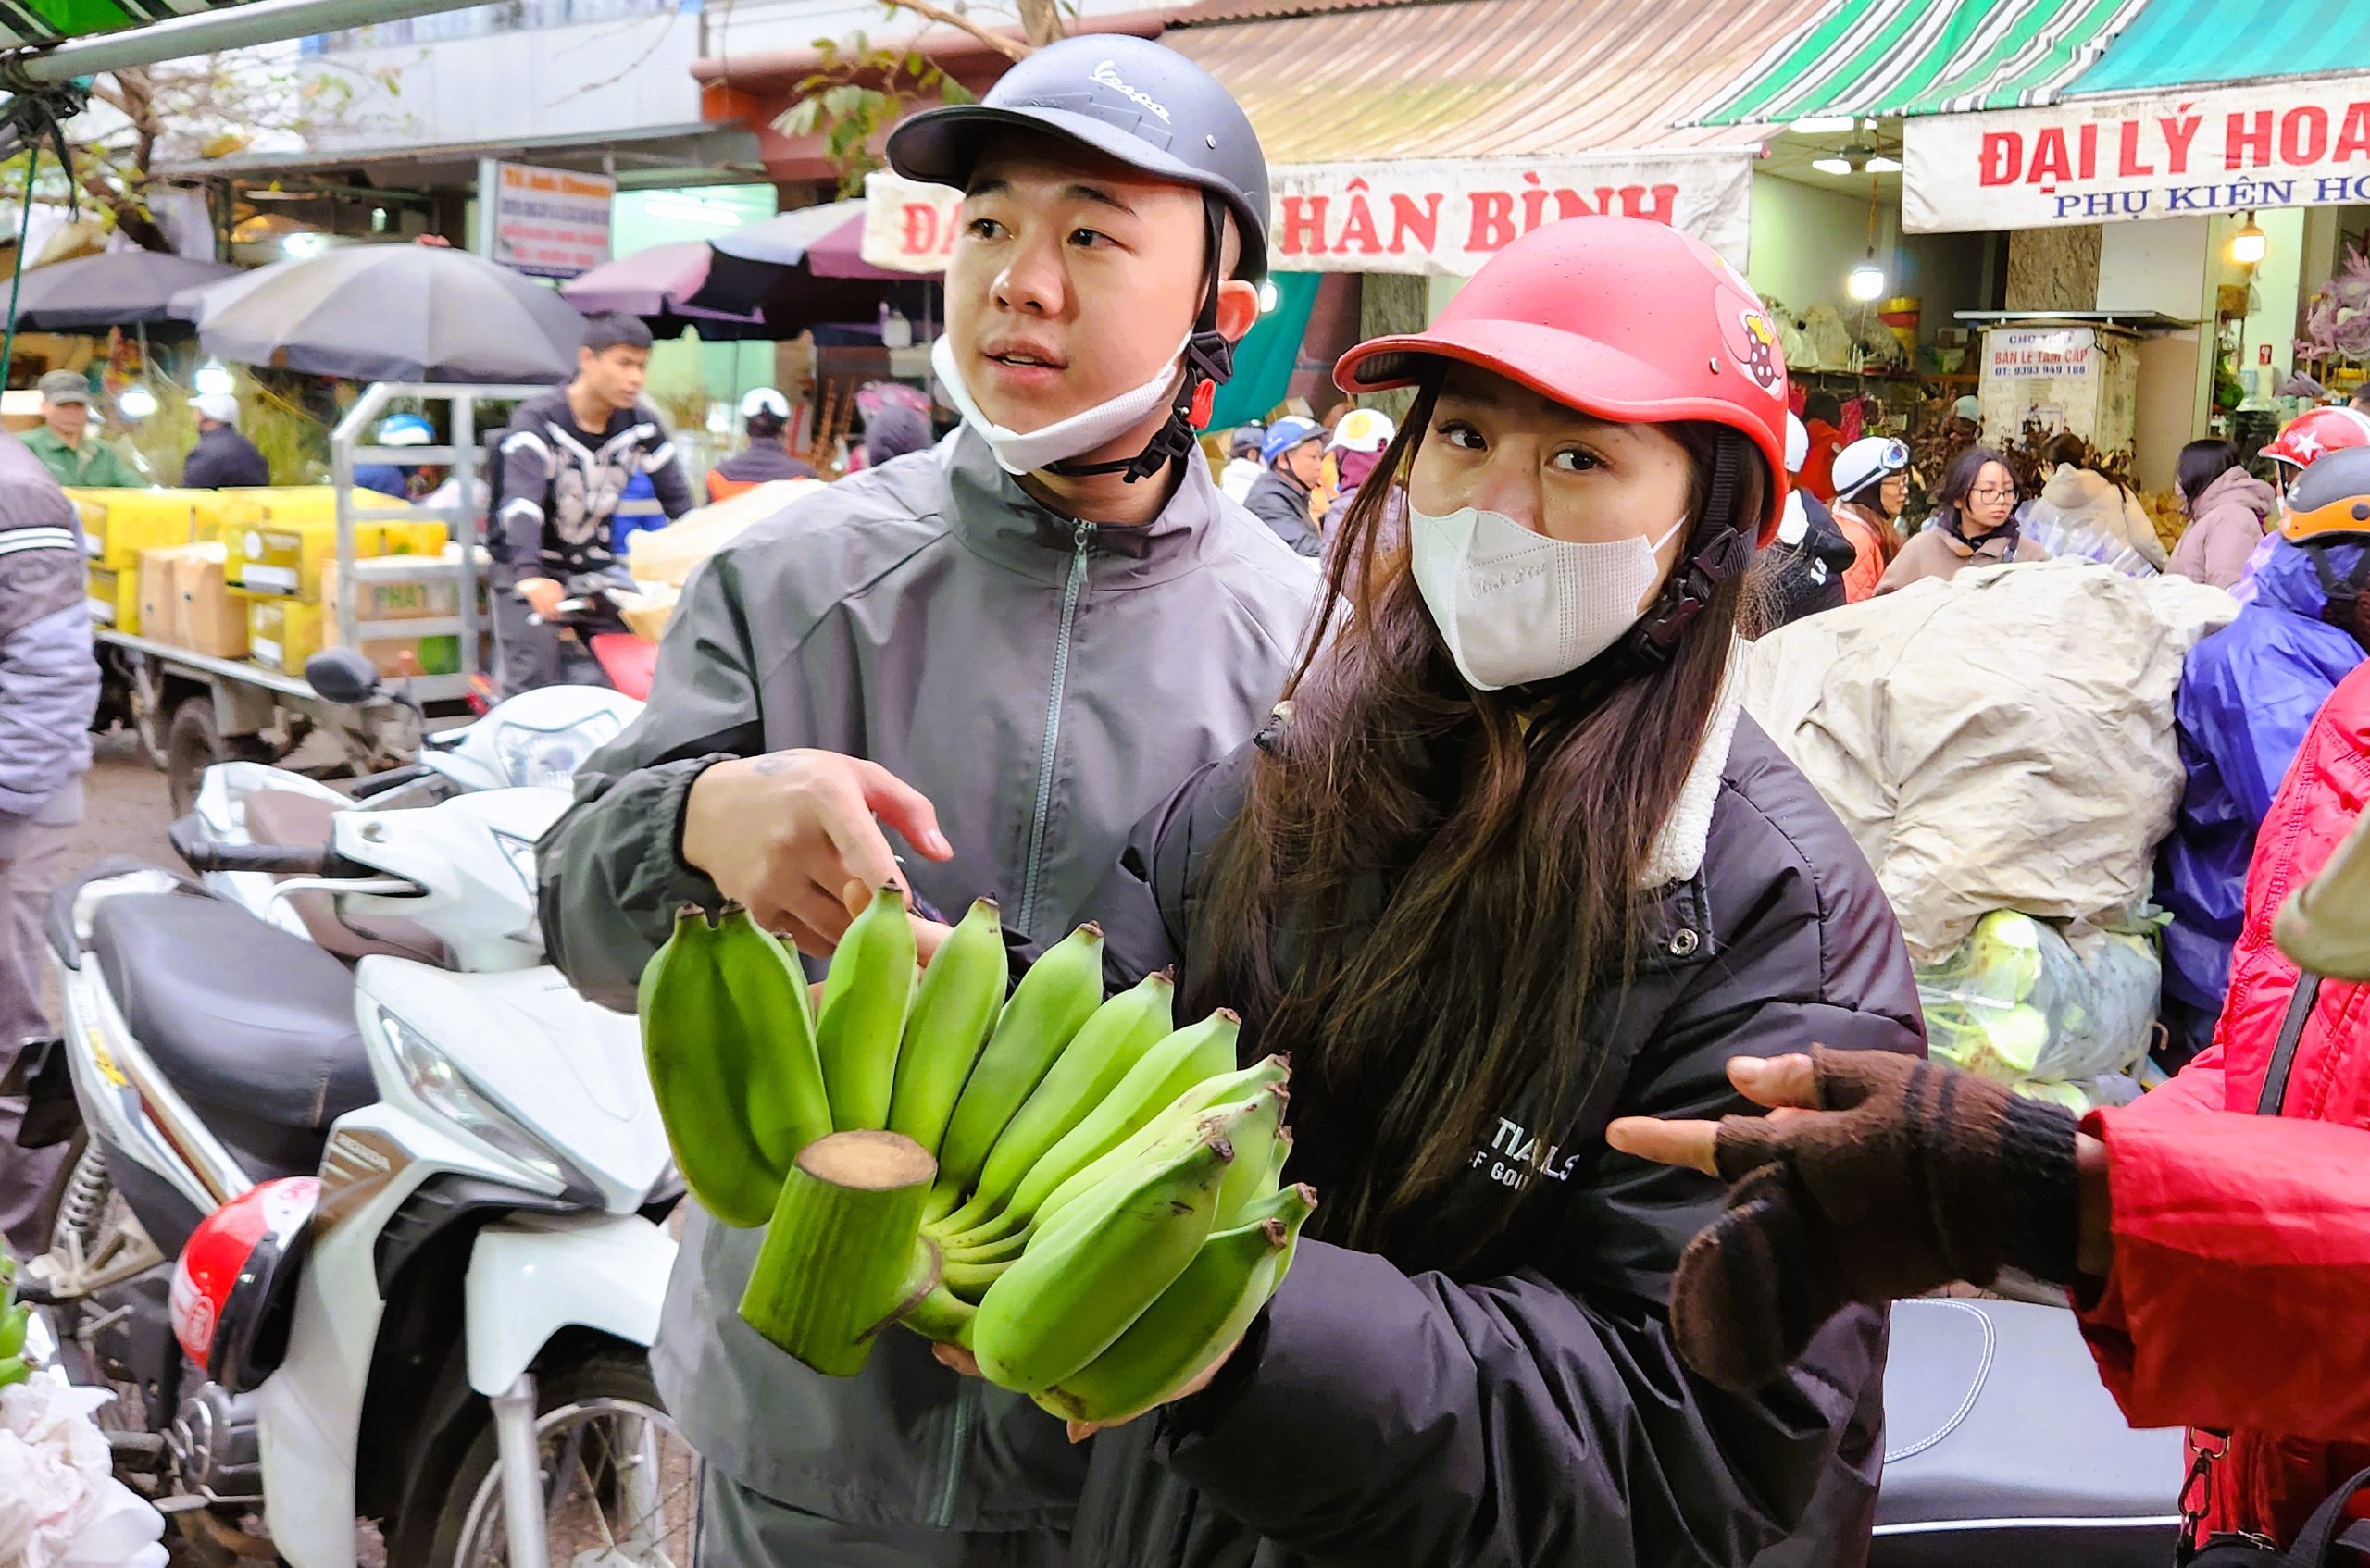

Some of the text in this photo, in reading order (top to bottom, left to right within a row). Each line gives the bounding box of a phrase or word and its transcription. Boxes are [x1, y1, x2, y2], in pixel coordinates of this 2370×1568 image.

[1087, 59, 1172, 126] Vespa
[1978, 123, 2099, 194] ĐẠI
[2119, 102, 2203, 178] LÝ
[2053, 189, 2153, 221] PHỤ
[2164, 176, 2298, 213] KIỆN
